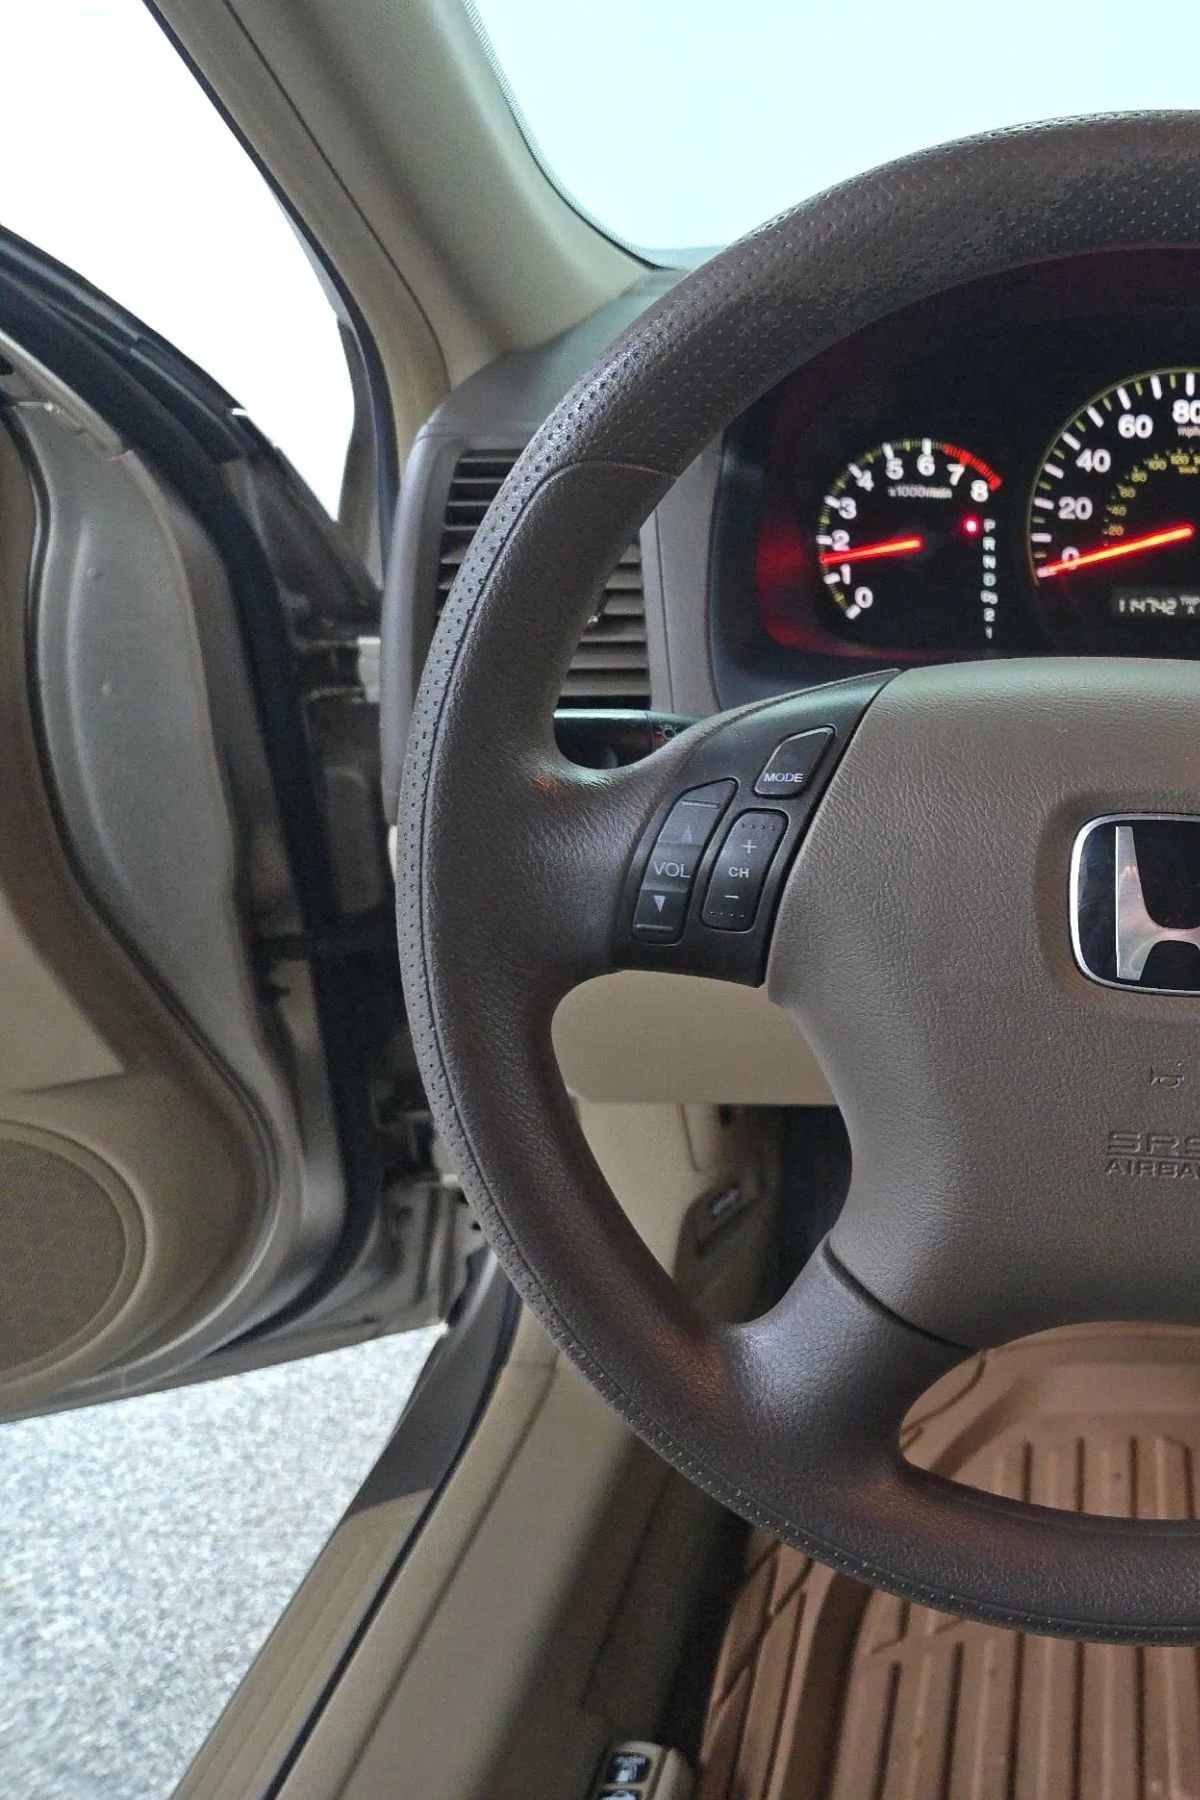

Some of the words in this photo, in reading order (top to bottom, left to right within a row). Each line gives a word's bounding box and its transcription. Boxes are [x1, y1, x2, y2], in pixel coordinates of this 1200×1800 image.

[1118, 414, 1153, 439] 60
[885, 457, 904, 480] 5
[917, 454, 935, 477] 6
[1075, 449, 1111, 473] 40
[857, 469, 875, 491] 4
[946, 463, 965, 485] 7
[970, 479, 989, 502] 8
[838, 497, 857, 519] 3
[1058, 496, 1093, 520] 20
[983, 518, 996, 532] P
[831, 529, 850, 551] 2
[983, 537, 996, 551] R
[983, 555, 996, 569] N
[840, 563, 851, 585] 1
[983, 573, 996, 587] D
[854, 586, 873, 608] 0
[983, 608, 996, 622] 2
[763, 773, 804, 783] MODE
[653, 862, 691, 879] VOL
[728, 866, 750, 878] CH
